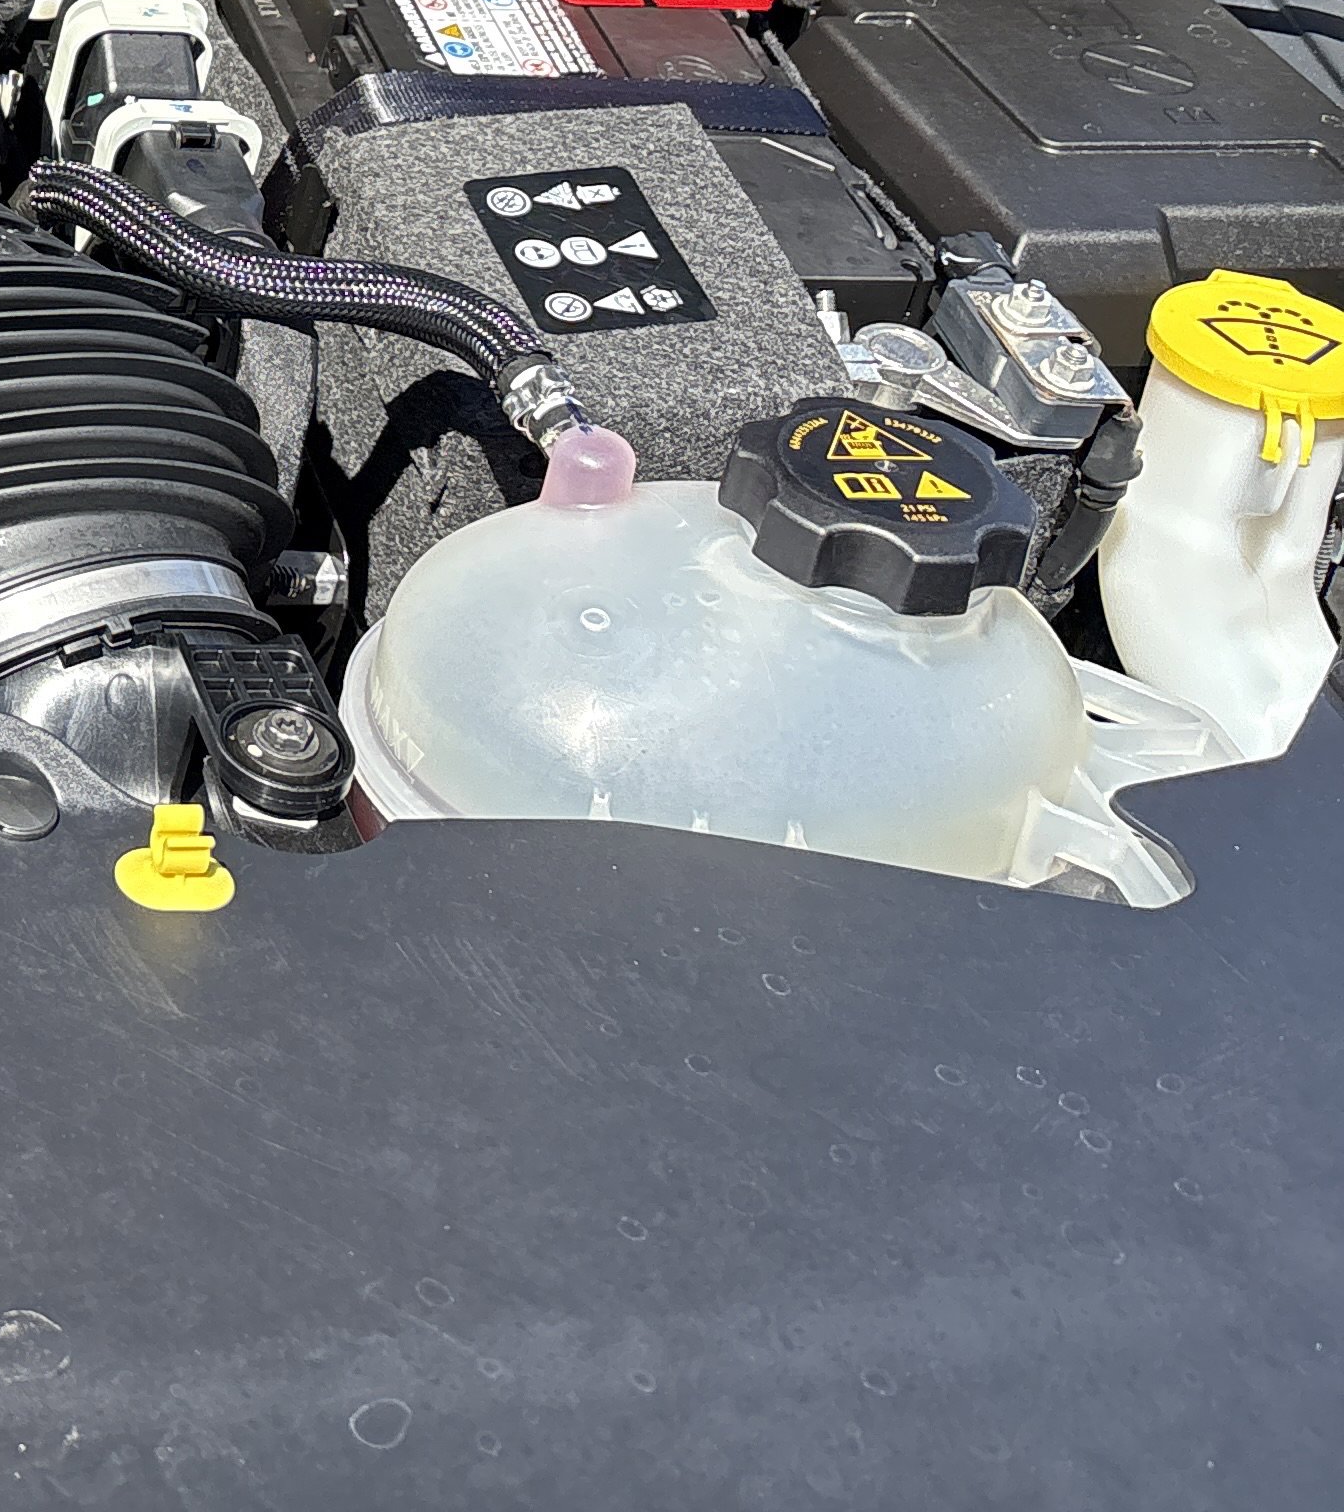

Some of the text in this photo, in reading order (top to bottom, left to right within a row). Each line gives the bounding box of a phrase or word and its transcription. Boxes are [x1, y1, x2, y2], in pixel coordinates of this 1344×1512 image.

[900, 503, 938, 514] 21 PSI
[902, 513, 925, 523] 145
